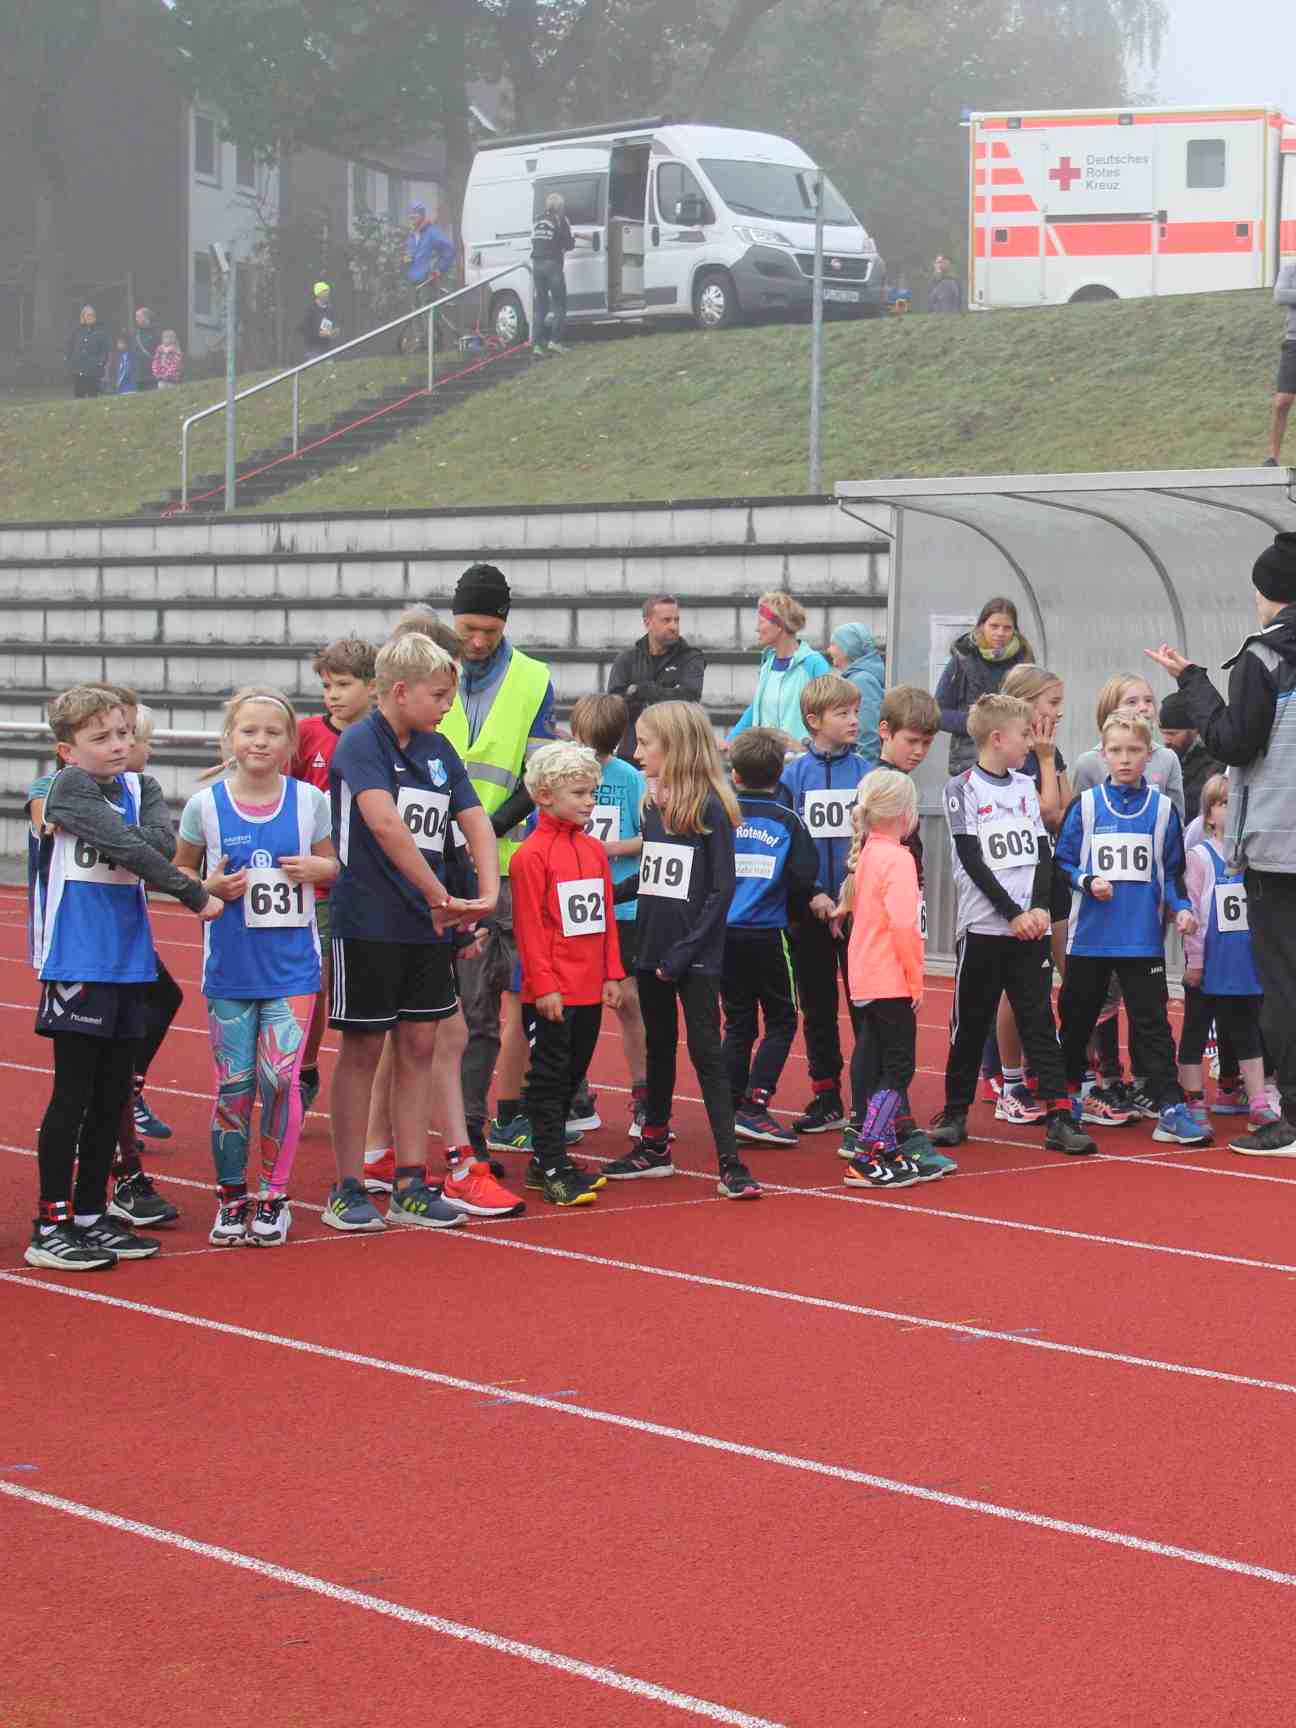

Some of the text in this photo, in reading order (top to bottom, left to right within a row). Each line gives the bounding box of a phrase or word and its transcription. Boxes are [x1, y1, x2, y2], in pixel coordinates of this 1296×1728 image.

[1086, 153, 1150, 166] Deutsches
[1086, 167, 1121, 178] Rotes
[1086, 180, 1120, 191] Kreuz
[403, 803, 449, 841] 604
[736, 825, 780, 848] Rotenhof
[988, 829, 1035, 860] 603
[1097, 844, 1149, 872] 616
[642, 855, 684, 887] 619
[250, 882, 304, 915] 631
[567, 892, 604, 924] 62
